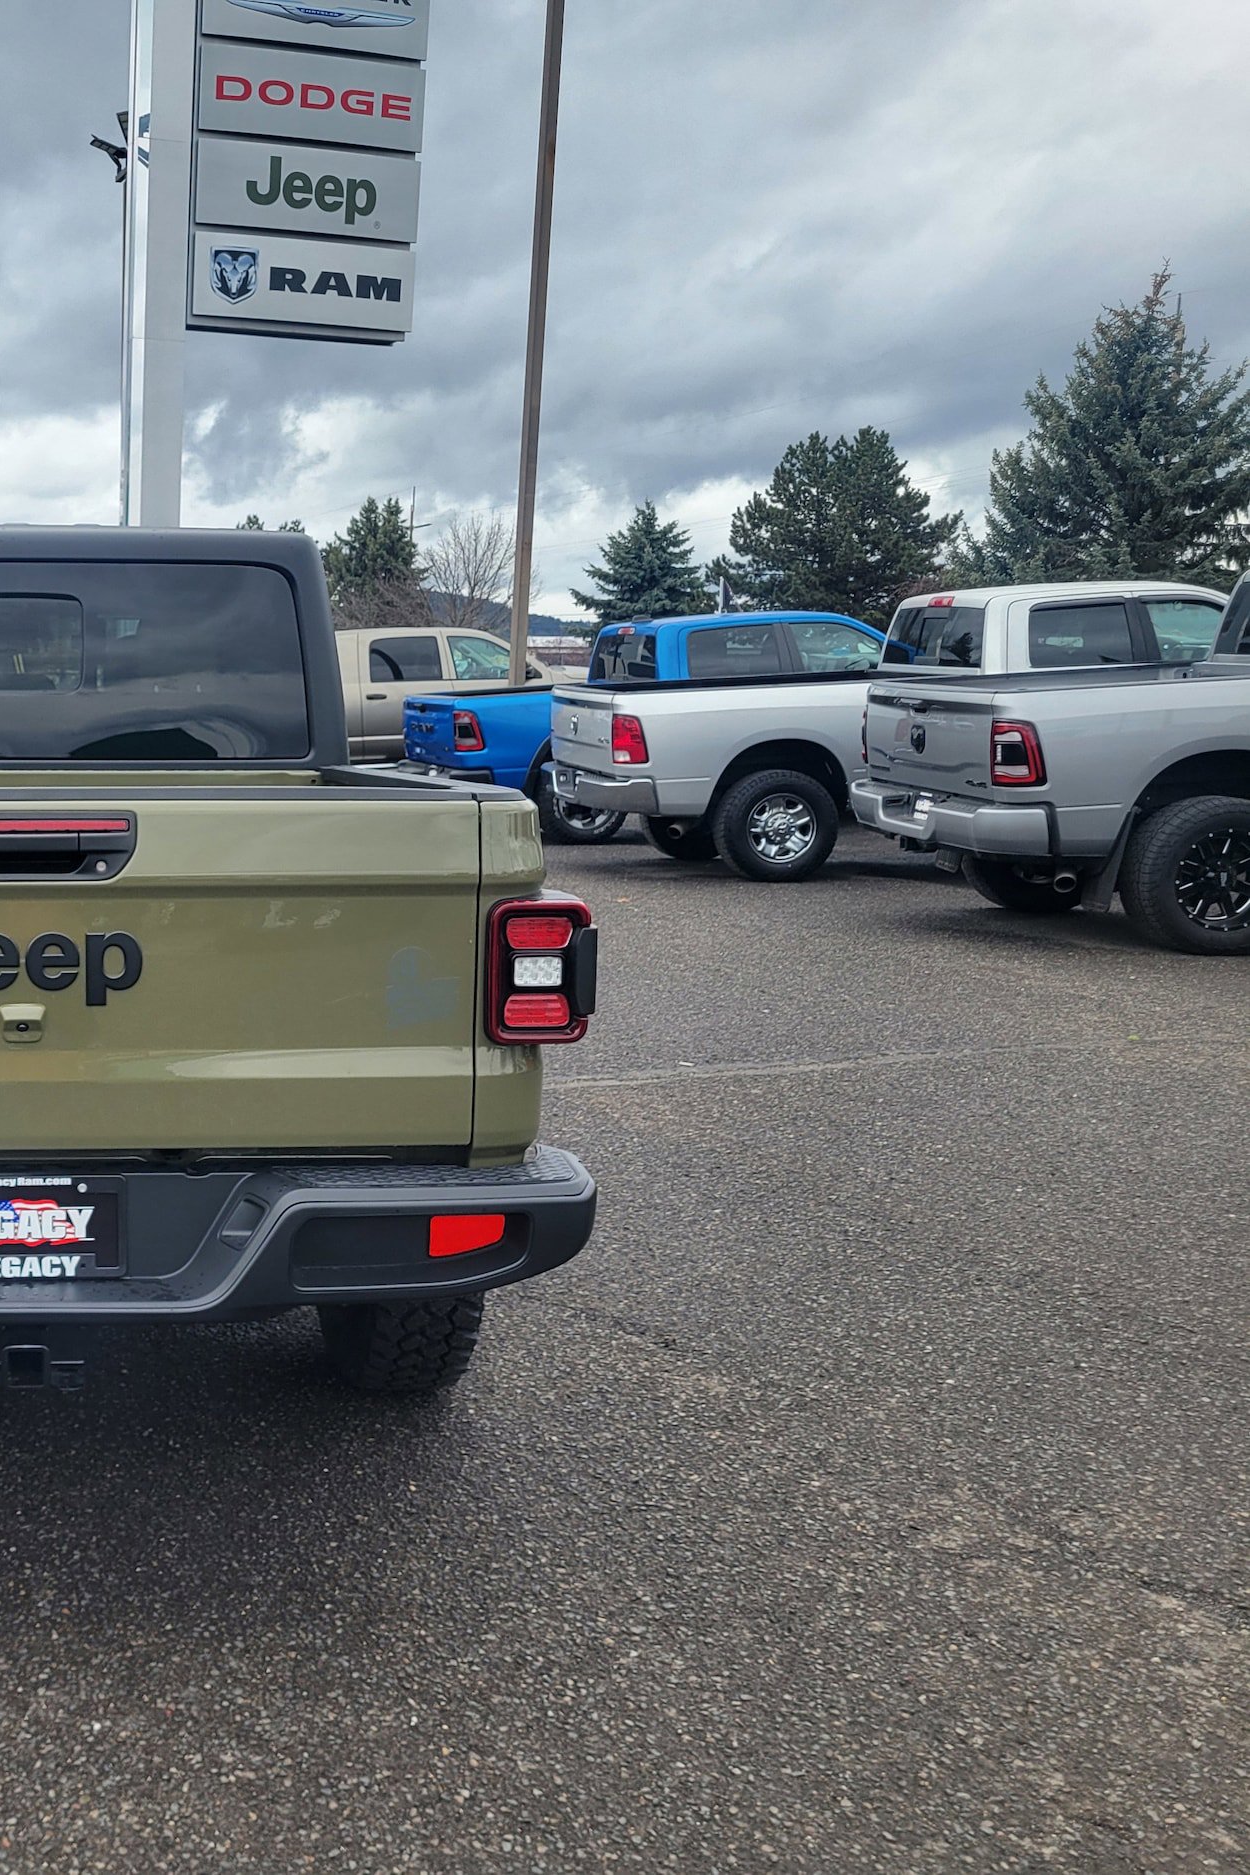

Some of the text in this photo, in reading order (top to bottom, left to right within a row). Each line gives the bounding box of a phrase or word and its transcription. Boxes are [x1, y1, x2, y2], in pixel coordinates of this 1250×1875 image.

[215, 75, 412, 121] DODGE
[246, 155, 377, 225] Jeep
[269, 266, 402, 302] RAM
